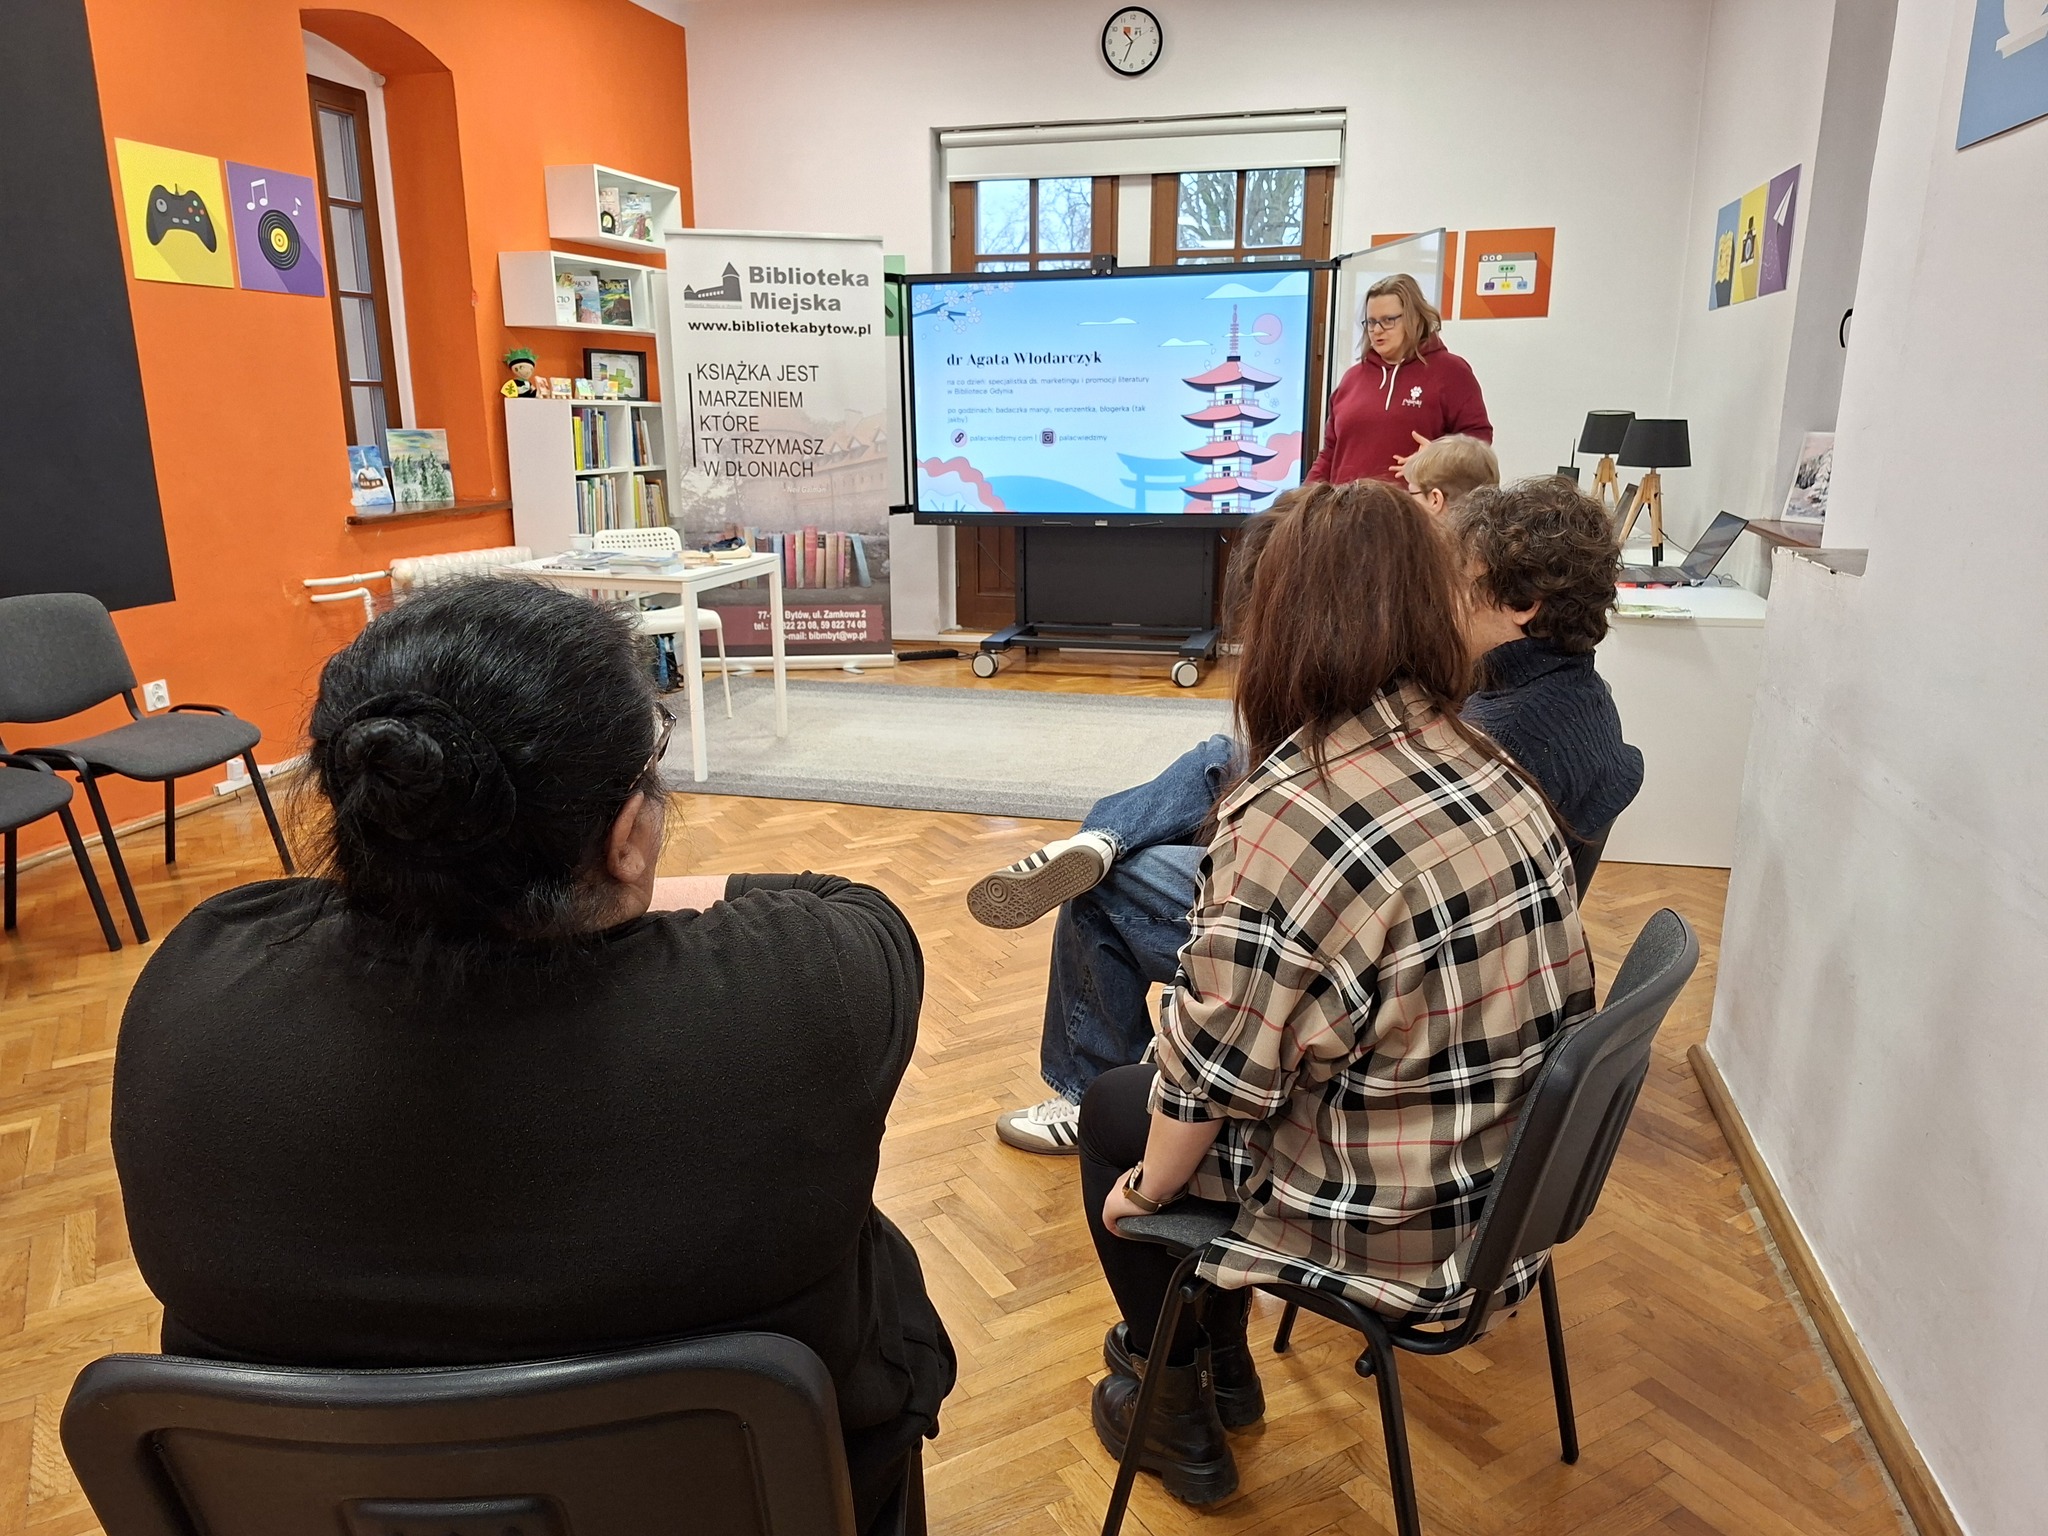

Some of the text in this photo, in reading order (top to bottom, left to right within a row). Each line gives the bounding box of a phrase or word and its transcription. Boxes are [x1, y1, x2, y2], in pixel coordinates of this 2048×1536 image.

[749, 266, 870, 287] Biblioteka
[750, 292, 842, 314] Miejska
[688, 320, 872, 336] www.bibliotekabytow.pl
[947, 354, 962, 366] dr
[967, 353, 1009, 369] Agata
[696, 360, 819, 385] KSIĄŻKA JEST
[988, 378, 1028, 386] specjalistka
[699, 390, 803, 408] MARZENIEM
[700, 412, 760, 432] KTÓRE
[701, 438, 824, 455] TY TRZYMASZ
[704, 460, 814, 477] W DŁONIACH
[785, 610, 811, 620] Bytów,
[812, 610, 822, 619] ul.
[823, 610, 860, 619] Zamkowa
[861, 609, 866, 618] 2
[754, 622, 769, 630] tel.:
[797, 621, 806, 630] 23
[821, 621, 830, 629] 59
[831, 621, 845, 629] 822
[846, 620, 856, 629] 74
